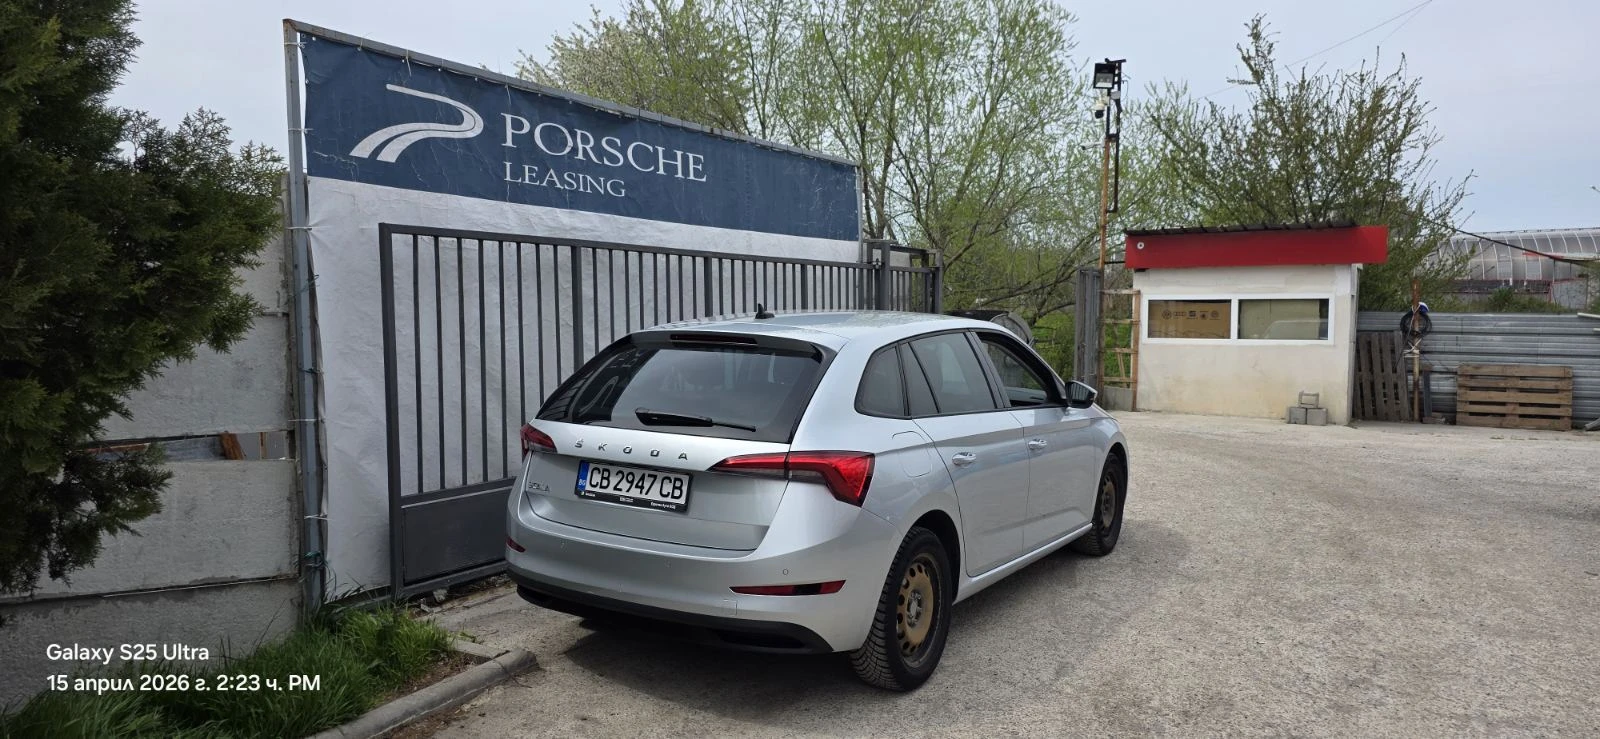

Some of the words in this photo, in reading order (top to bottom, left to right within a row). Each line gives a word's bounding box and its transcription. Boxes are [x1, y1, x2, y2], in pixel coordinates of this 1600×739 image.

[501, 112, 707, 182] PORSCHE
[503, 161, 626, 197] LEASING
[589, 467, 610, 489] CB
[613, 470, 657, 496] 2947
[659, 476, 684, 500] CB
